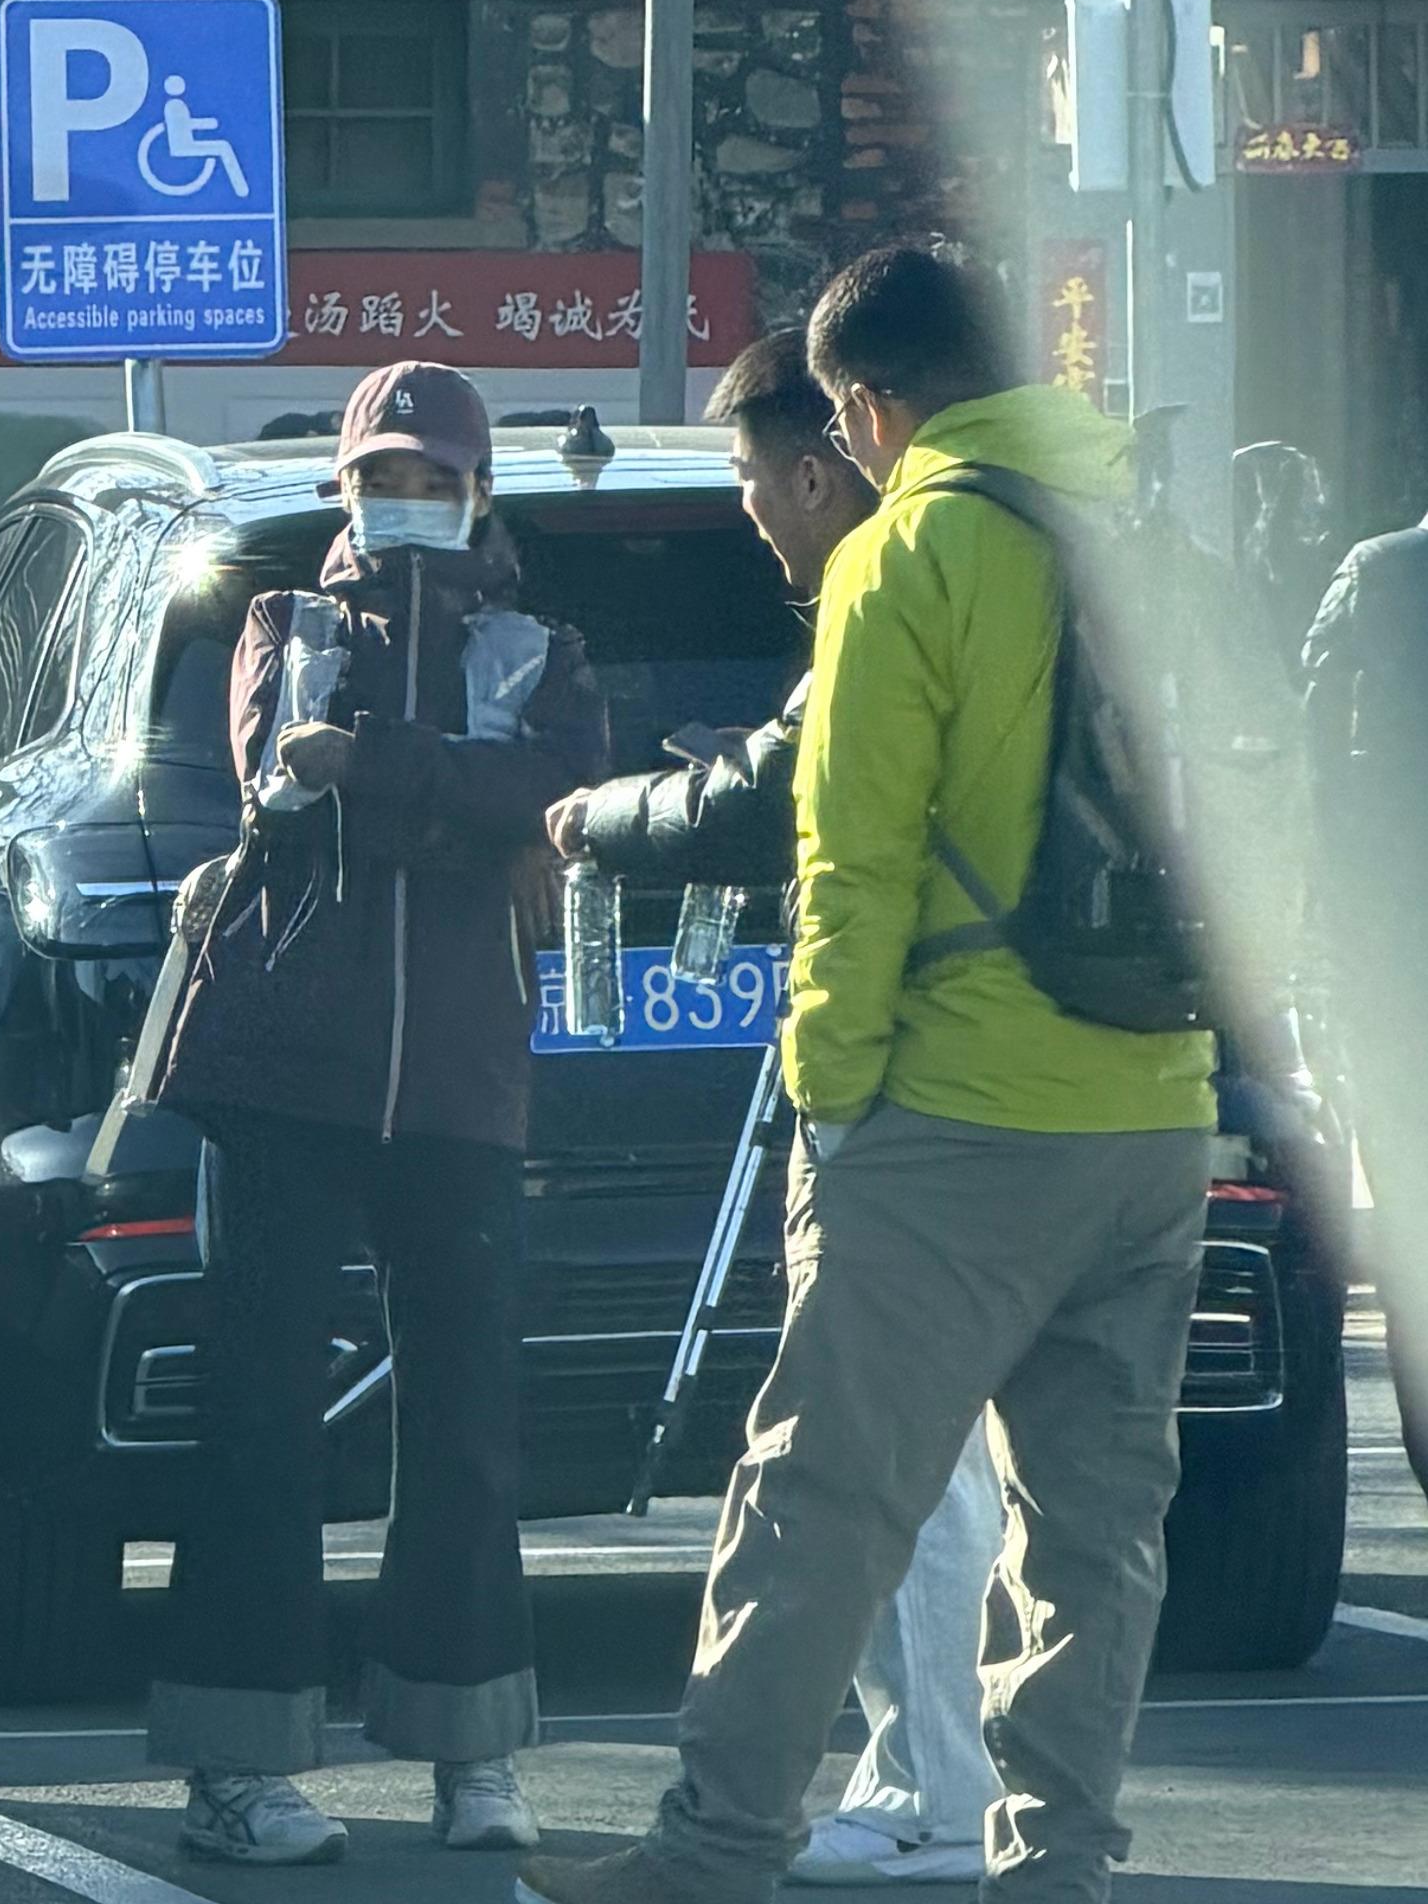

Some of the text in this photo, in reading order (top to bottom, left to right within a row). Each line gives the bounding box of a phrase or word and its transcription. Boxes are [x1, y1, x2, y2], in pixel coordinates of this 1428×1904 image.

[29, 18, 149, 202] P
[20, 239, 266, 296] 无障碍停车位
[24, 303, 266, 332] Accessible parking spaces
[287, 289, 465, 338] 汤蹈火
